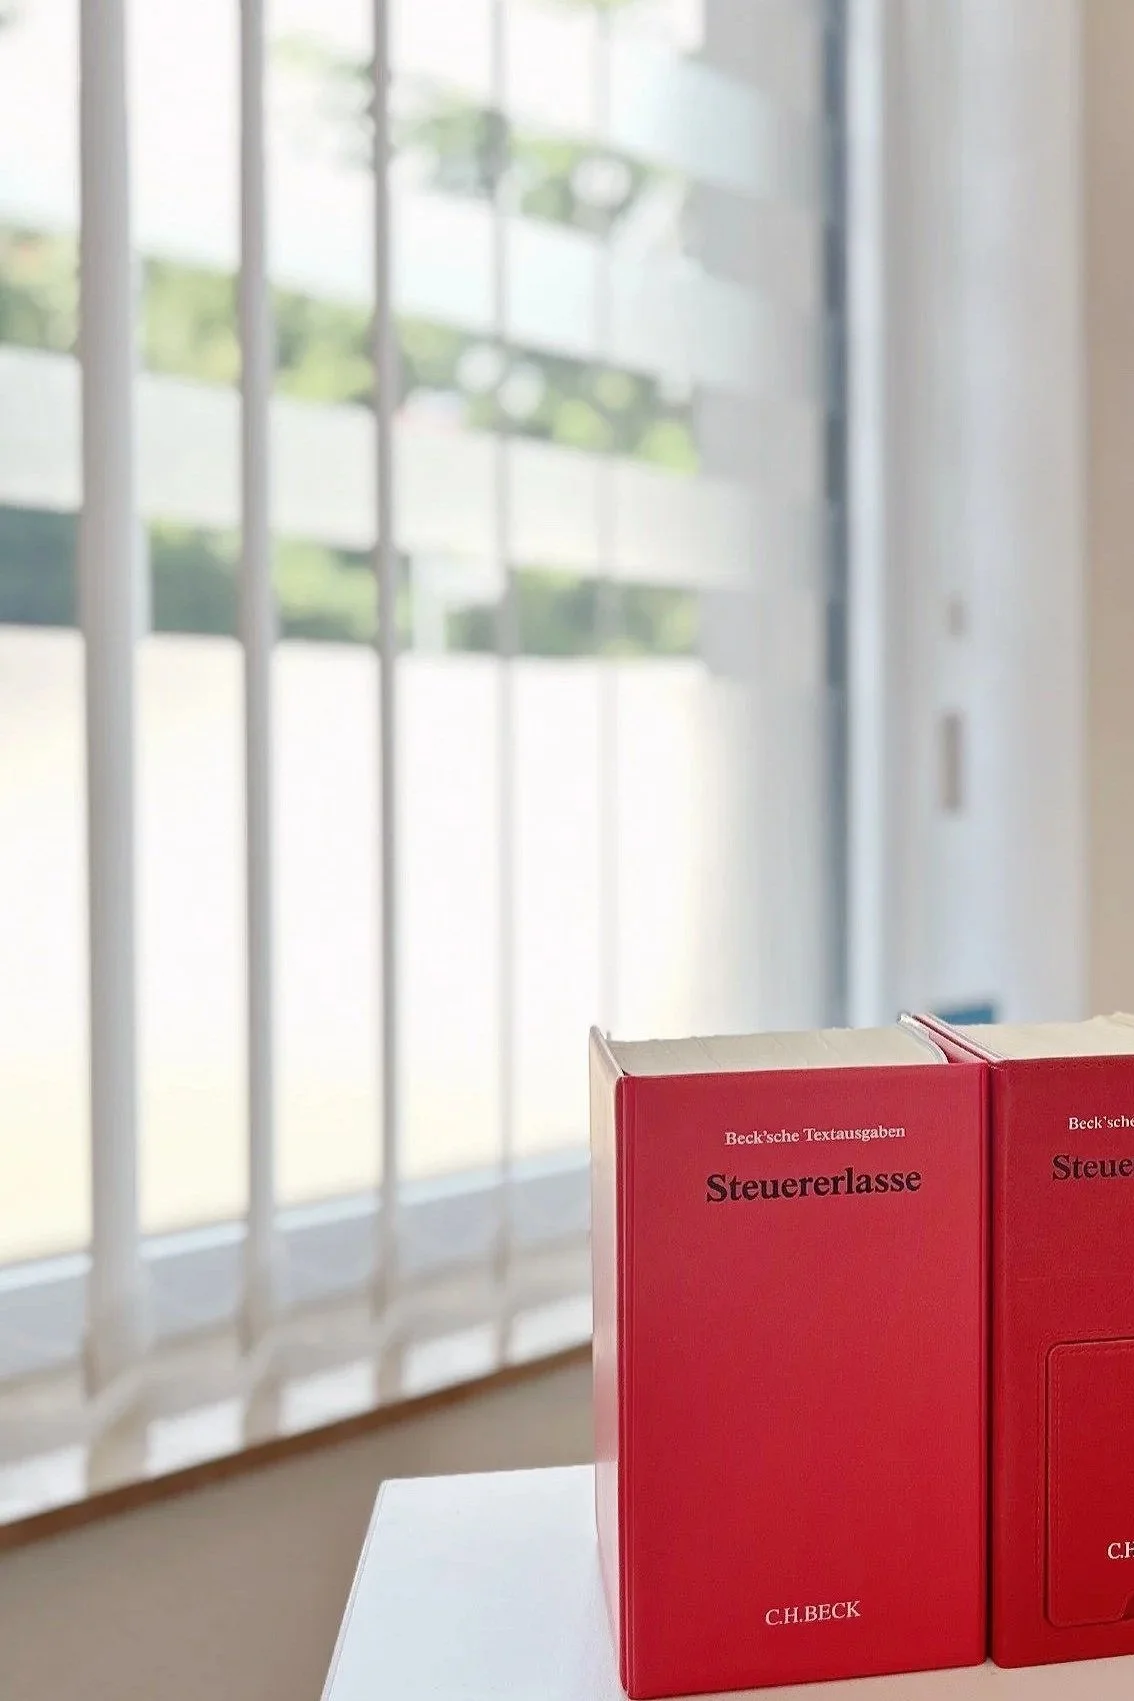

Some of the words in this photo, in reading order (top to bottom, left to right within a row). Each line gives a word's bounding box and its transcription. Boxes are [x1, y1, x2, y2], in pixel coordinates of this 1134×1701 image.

[803, 1124, 906, 1144] Textausgaben
[706, 1167, 922, 1203] Steuererlasse
[764, 1599, 862, 1626] C.H.BECK
